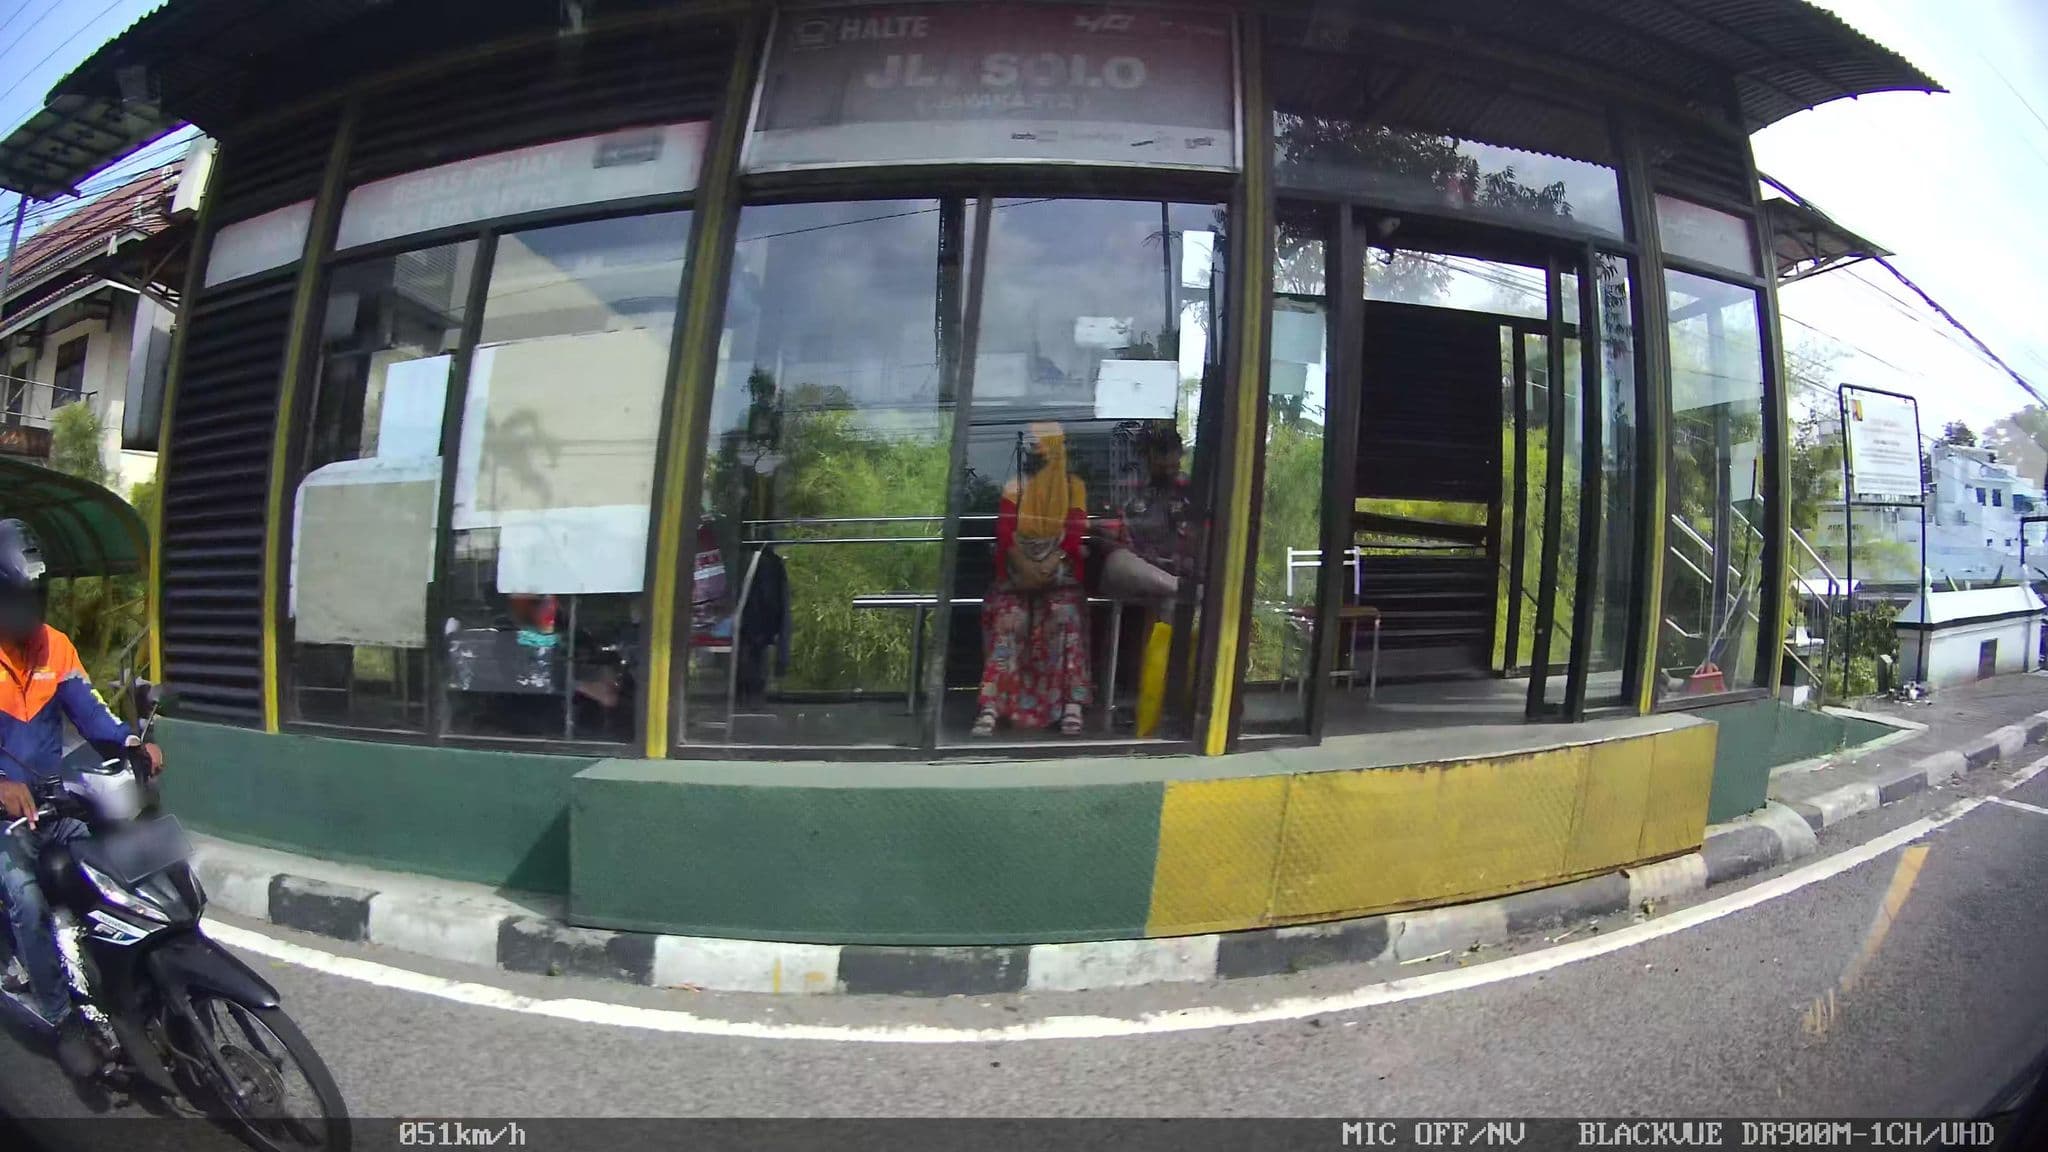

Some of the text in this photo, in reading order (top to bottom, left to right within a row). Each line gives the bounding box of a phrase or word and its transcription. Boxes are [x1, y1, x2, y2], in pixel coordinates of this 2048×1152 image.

[840, 15, 929, 40] HALTE
[863, 52, 1146, 89] JL. SOLO
